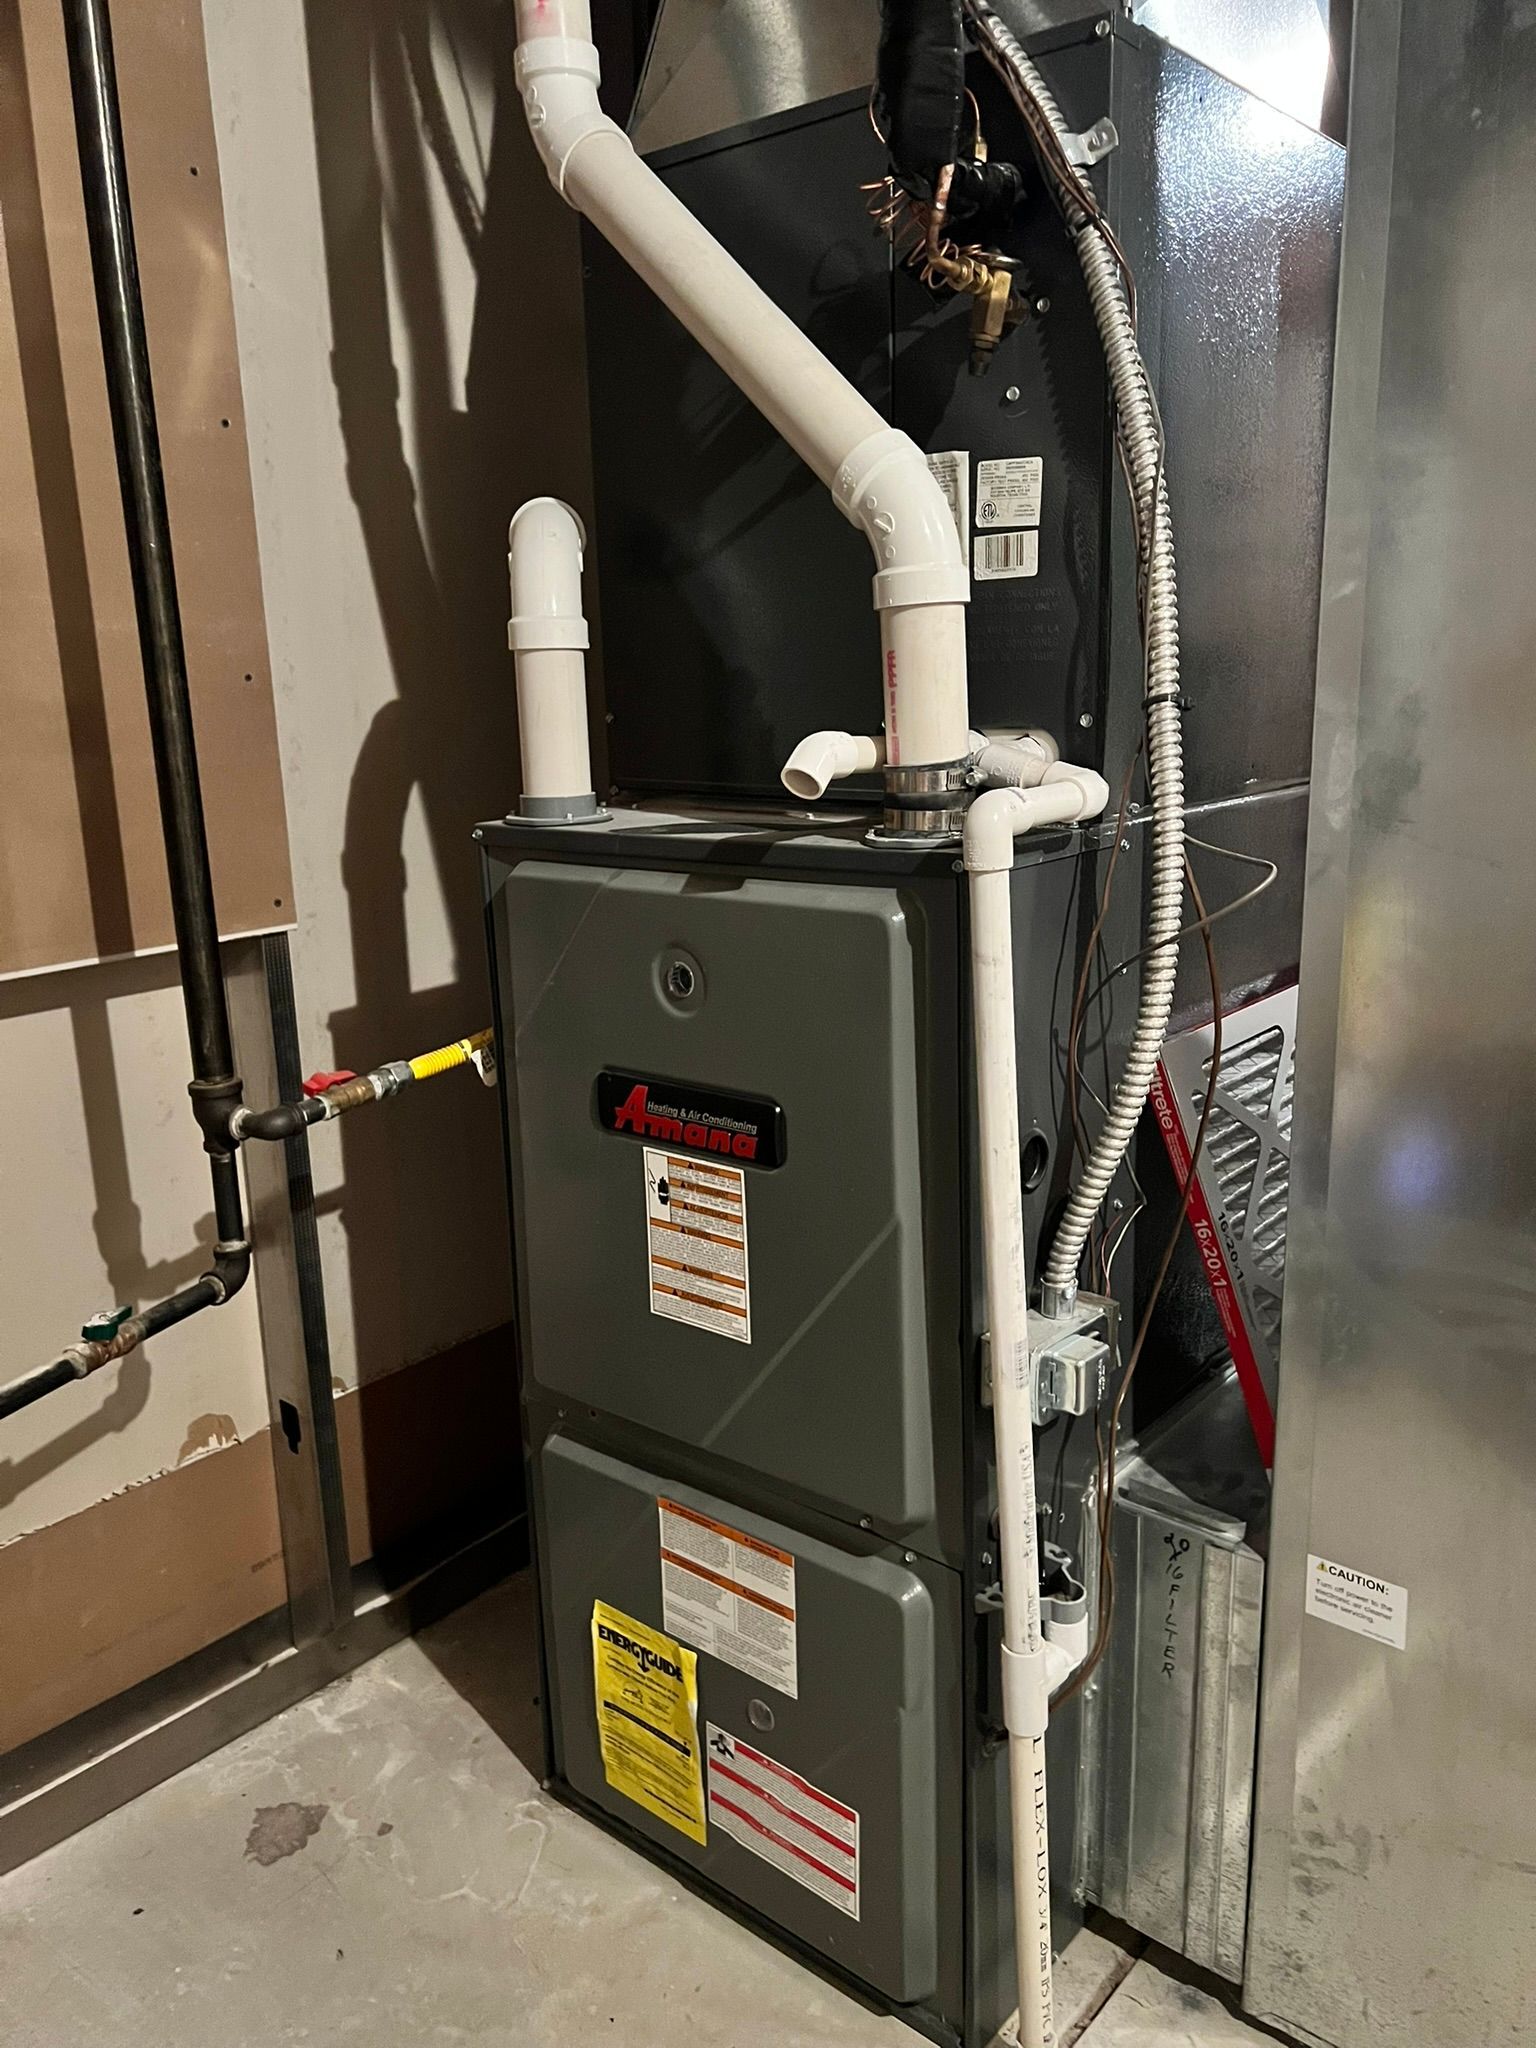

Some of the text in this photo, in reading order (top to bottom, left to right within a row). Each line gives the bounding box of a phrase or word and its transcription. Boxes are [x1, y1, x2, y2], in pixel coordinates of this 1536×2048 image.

[615, 1084, 758, 1159] Amana
[647, 1101, 757, 1135] Heating & Air Conditioning
[1328, 1566, 1390, 1596] CAUTION:
[598, 1623, 684, 1684] ENERGYGUIDE
[1161, 1584, 1180, 1680] FILTER
